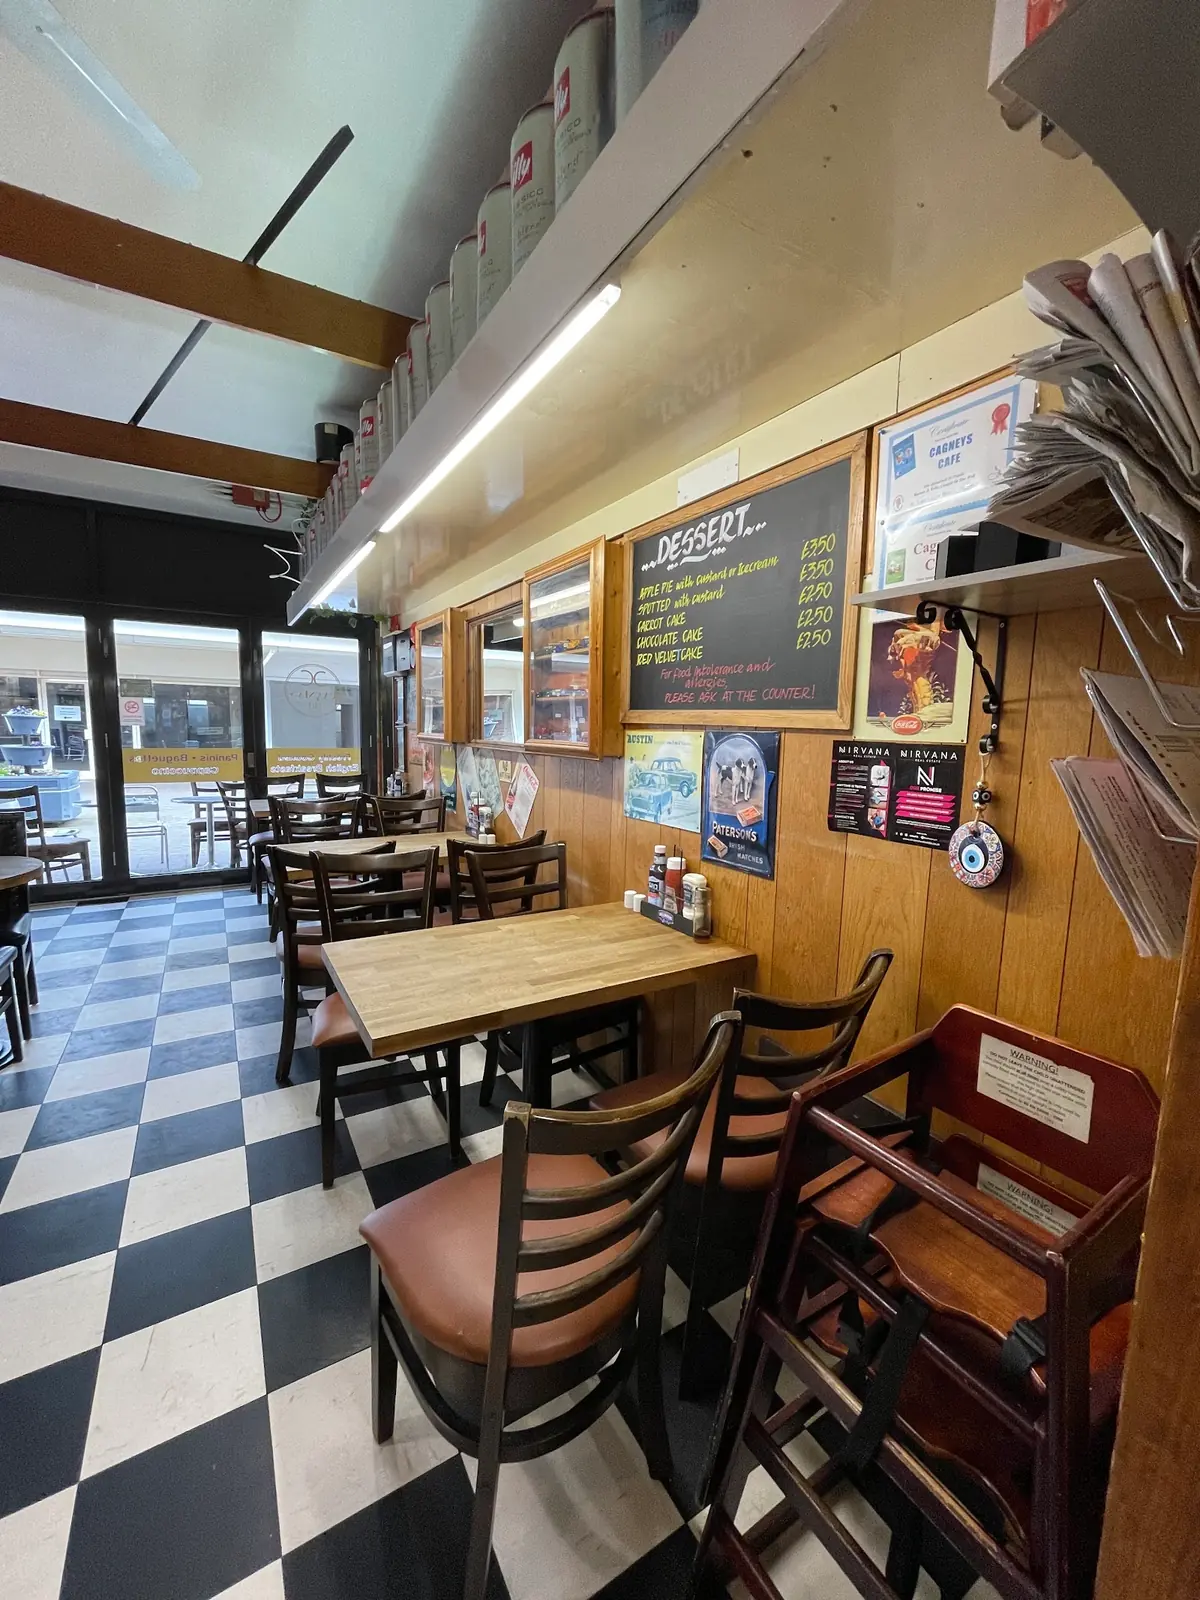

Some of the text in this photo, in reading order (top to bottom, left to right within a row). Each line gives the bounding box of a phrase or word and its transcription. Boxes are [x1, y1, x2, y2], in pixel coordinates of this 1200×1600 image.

[929, 433, 973, 458] CAGNEYS
[938, 452, 961, 469] CAFE
[801, 532, 836, 560] £3.50
[914, 542, 936, 554] Cag
[799, 558, 834, 582] £3.50
[637, 583, 660, 600] APPLE
[661, 580, 674, 594] PIE
[675, 575, 695, 591] with
[696, 567, 727, 585] custard
[728, 567, 738, 578] or
[798, 581, 833, 605] £2.50
[637, 584, 726, 616] SPOTTED with custard
[637, 612, 687, 633] CARROT CAKE
[797, 605, 833, 629] £2.50
[636, 626, 704, 649] CHOCOLATE CAKE
[796, 628, 832, 650] £2.50
[636, 645, 704, 666] RED VELVET CAKE
[660, 655, 776, 683] For food intolerance and
[664, 684, 816, 704] PLEASE ASK AT THE COUNTER!
[627, 734, 653, 744] AUSTIN
[838, 746, 890, 756] NIRVANA
[900, 750, 958, 760] NIRVANA
[712, 820, 757, 842] PATERSON'S
[729, 841, 746, 850] IRISH
[737, 852, 764, 865] MATCHES
[1009, 1048, 1059, 1076] WARNING!
[1006, 1182, 1054, 1215] WARNING!
